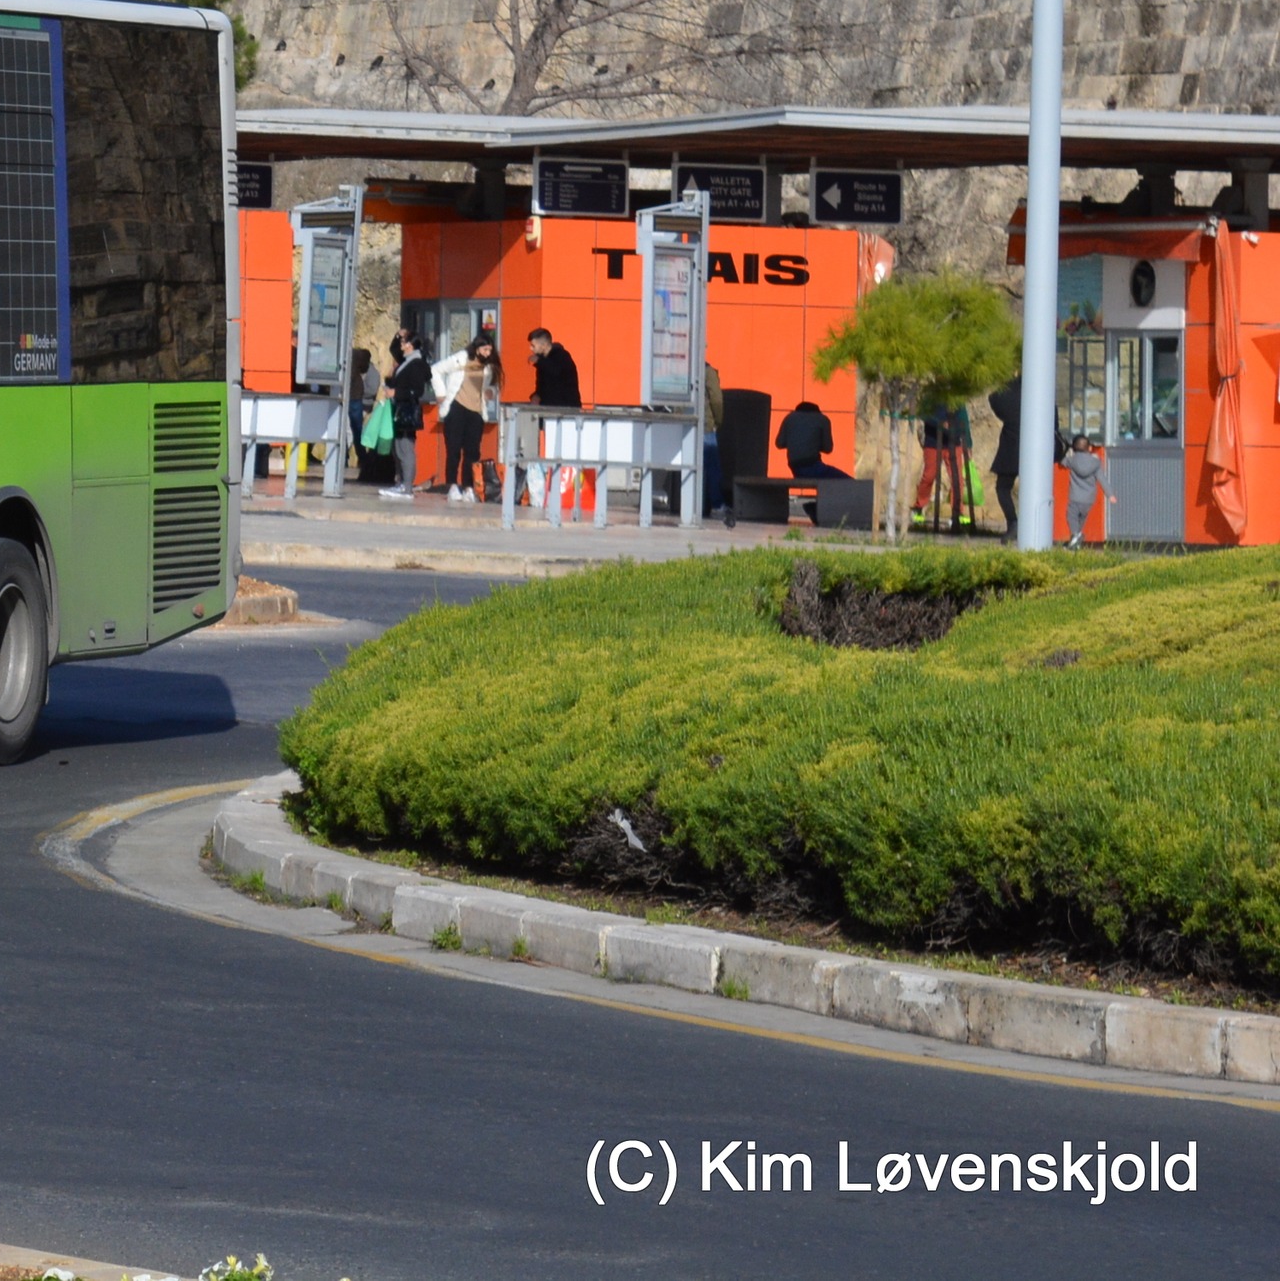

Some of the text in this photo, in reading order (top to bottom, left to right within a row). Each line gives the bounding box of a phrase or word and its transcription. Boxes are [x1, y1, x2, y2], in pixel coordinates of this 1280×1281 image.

[709, 175, 752, 186] VALLETTA
[853, 181, 877, 192] Route
[730, 188, 752, 197] GATE
[853, 203, 869, 215] Bay
[591, 247, 811, 287] TAIS
[13, 352, 57, 372] GERMANY
